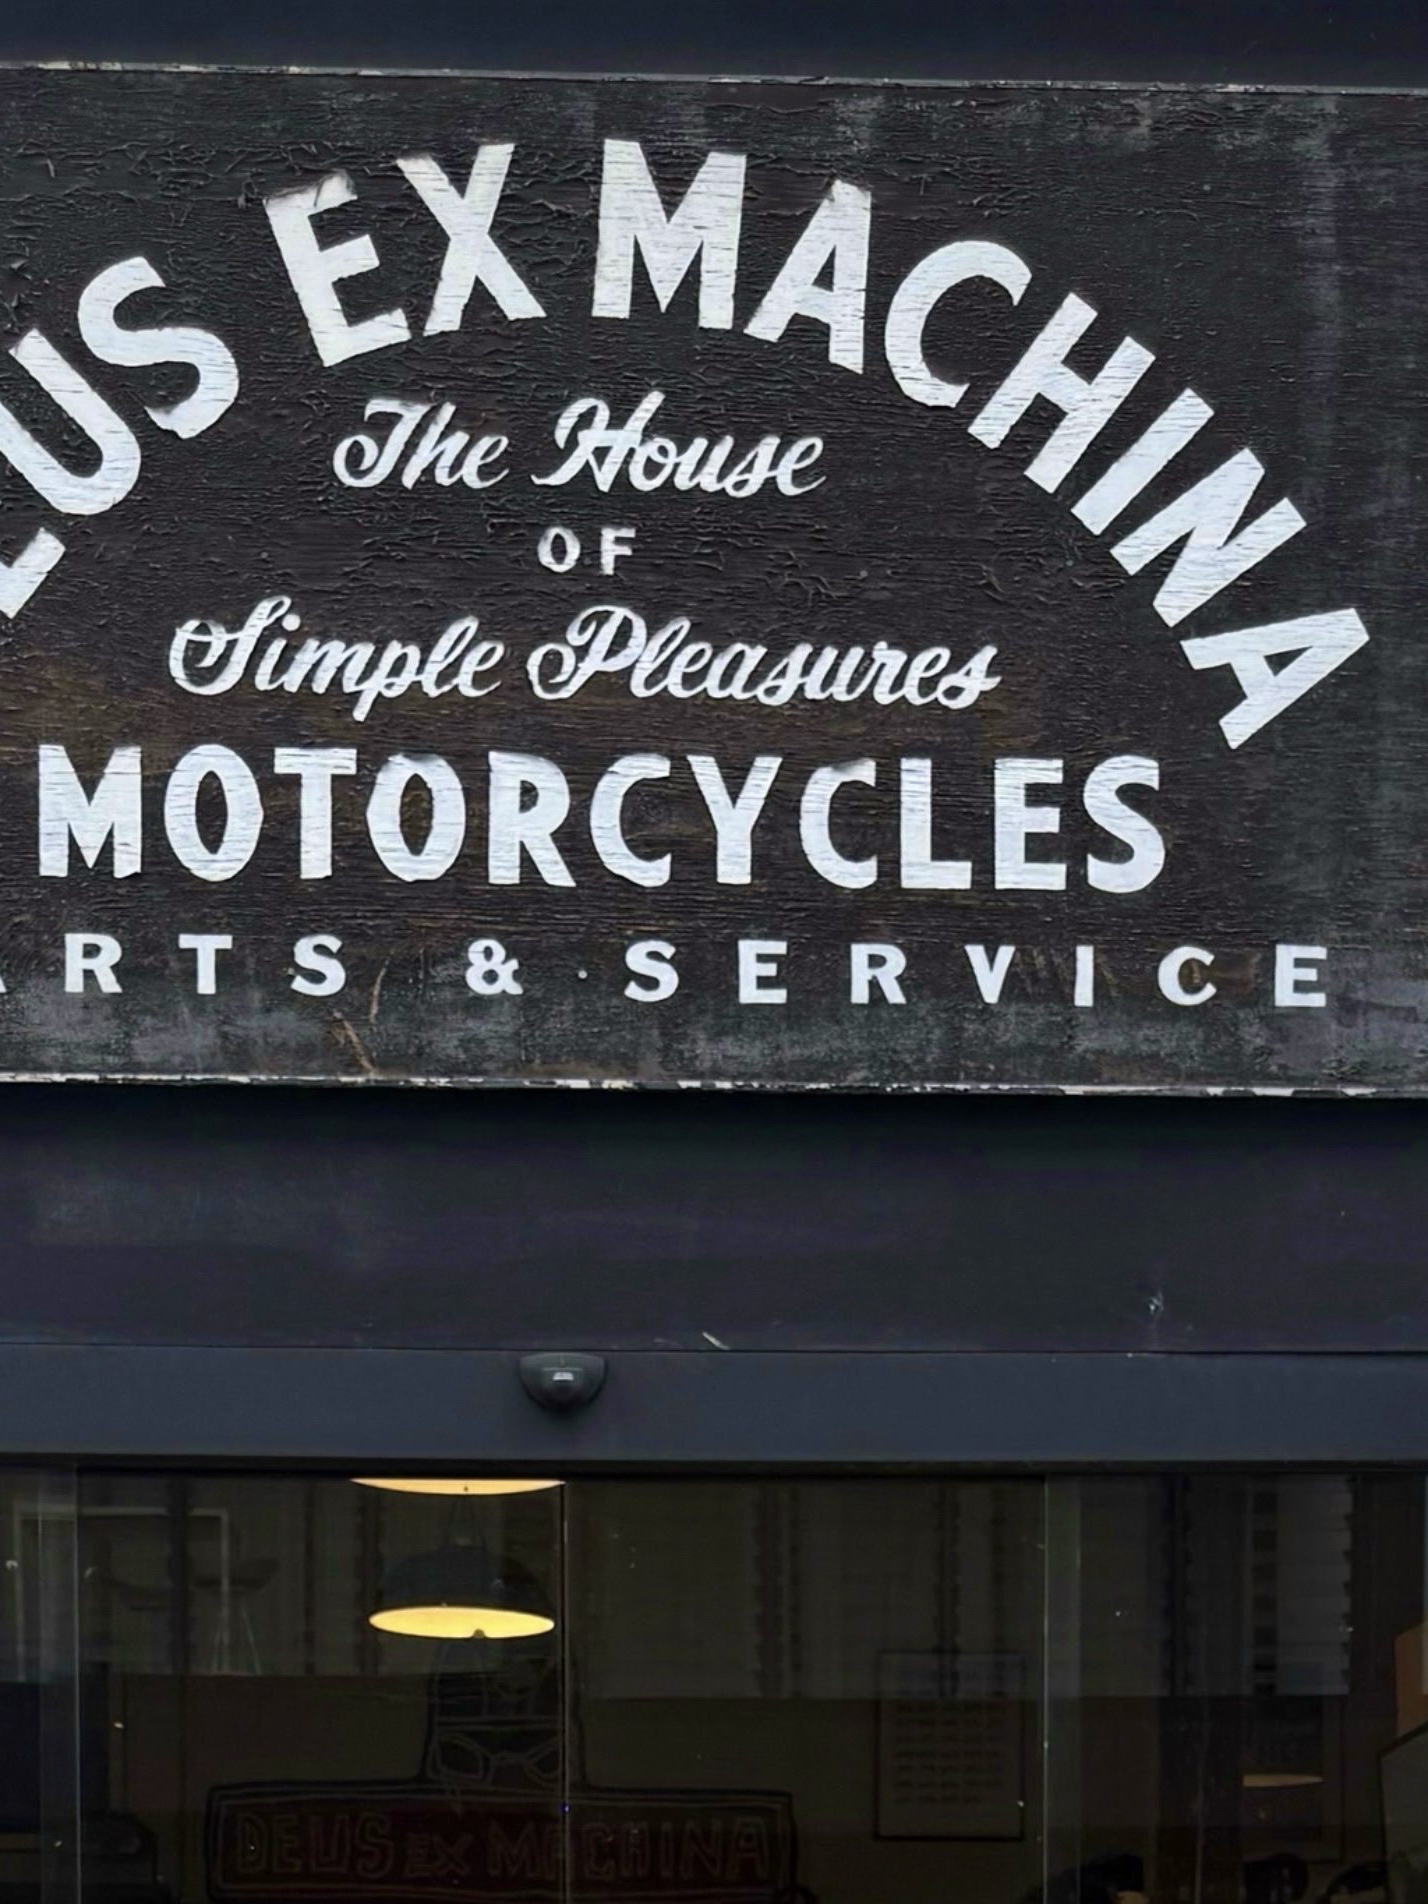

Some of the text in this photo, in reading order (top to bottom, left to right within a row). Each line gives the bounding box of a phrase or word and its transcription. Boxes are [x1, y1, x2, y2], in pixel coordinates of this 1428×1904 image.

[266, 143, 545, 367] EX
[592, 138, 1369, 749] MACHINA
[333, 390, 826, 498] The House
[537, 527, 636, 576] OF
[168, 597, 1000, 722] Simple Pleasures
[38, 744, 1172, 894] MOTORCYCLES
[465, 938, 523, 998] &
[624, 939, 1328, 1008] SERVICE
